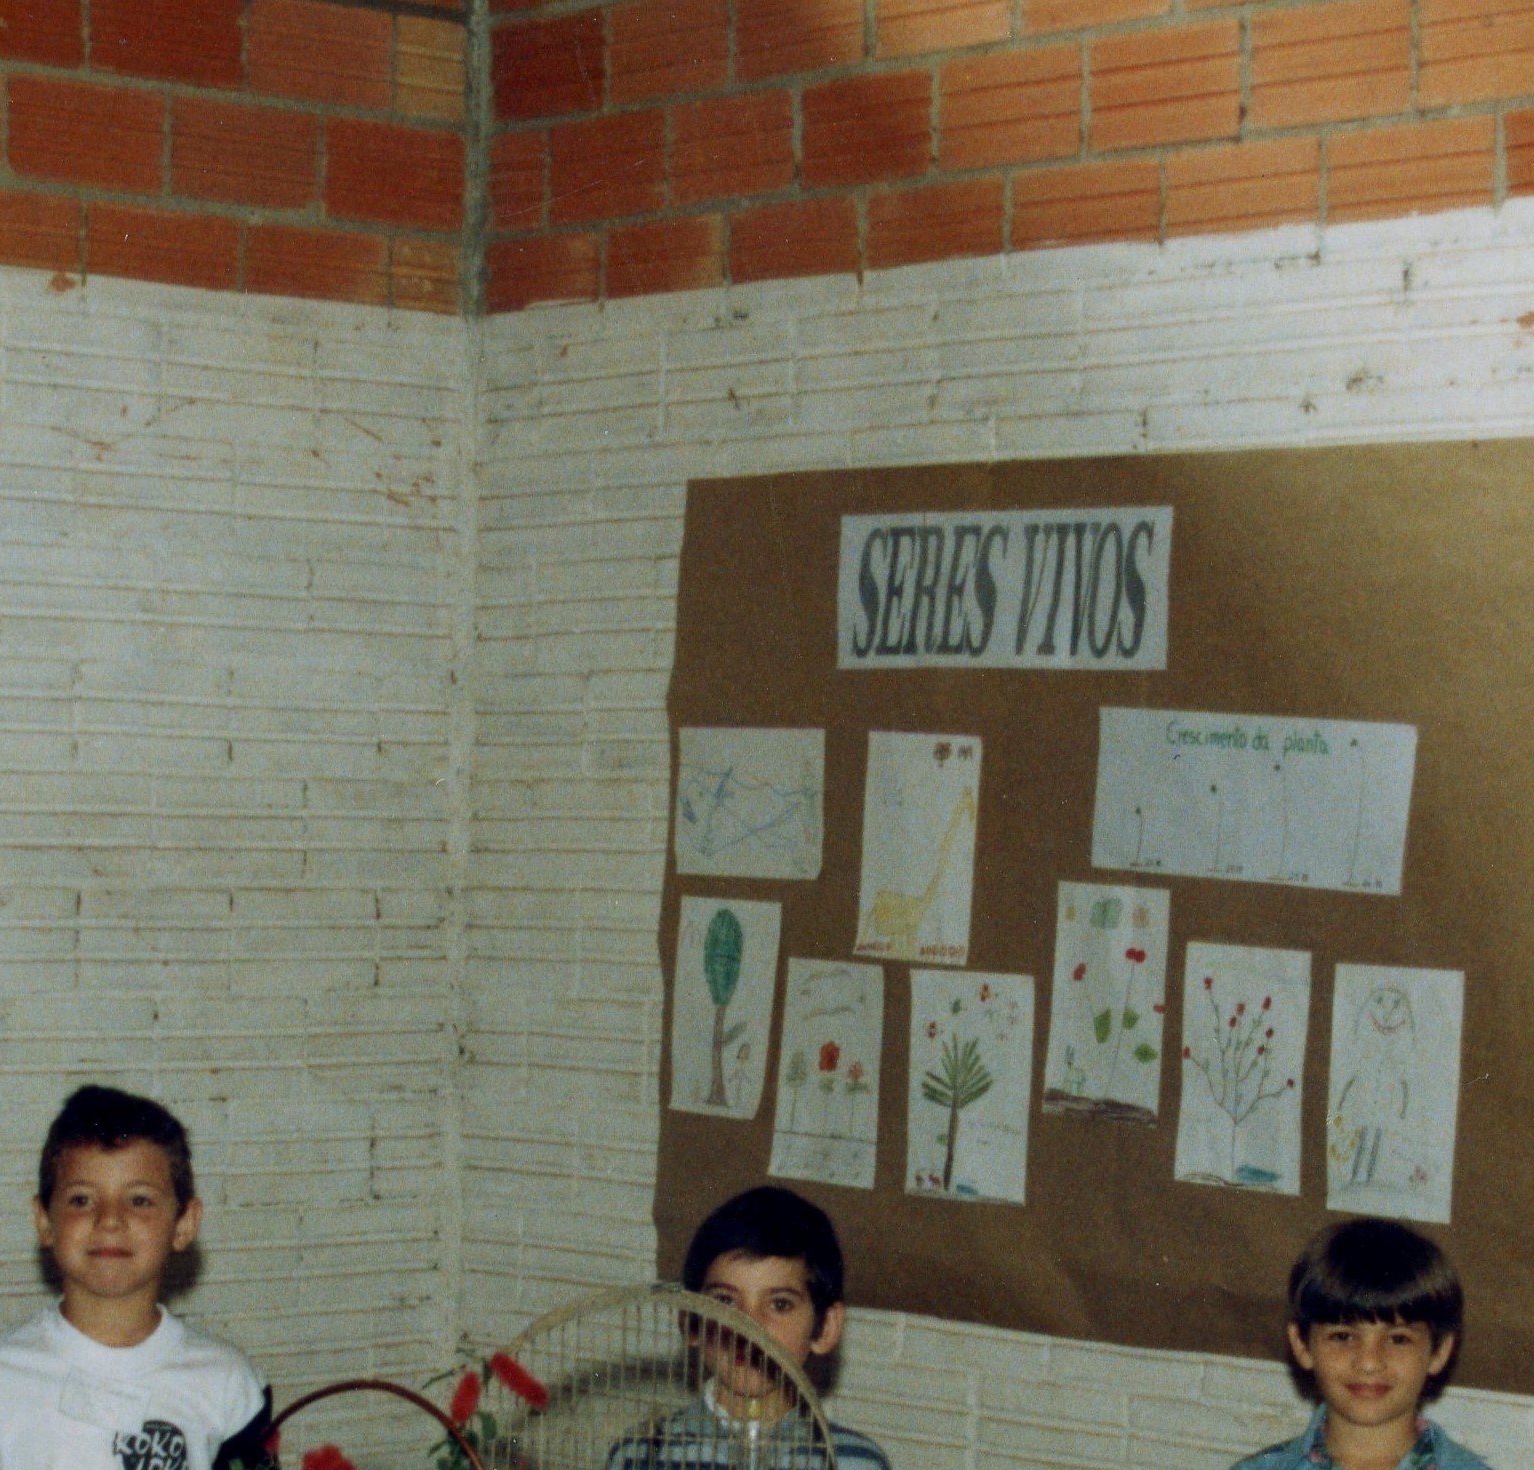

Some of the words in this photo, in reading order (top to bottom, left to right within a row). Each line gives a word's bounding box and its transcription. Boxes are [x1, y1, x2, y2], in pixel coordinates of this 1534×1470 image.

[851, 524, 1007, 657] SERES
[1015, 520, 1154, 658] VIVOS
[1165, 720, 1248, 749] Crescimento
[1251, 725, 1269, 751] da
[1282, 729, 1330, 758] planta
[113, 1430, 185, 1458] KOKO
